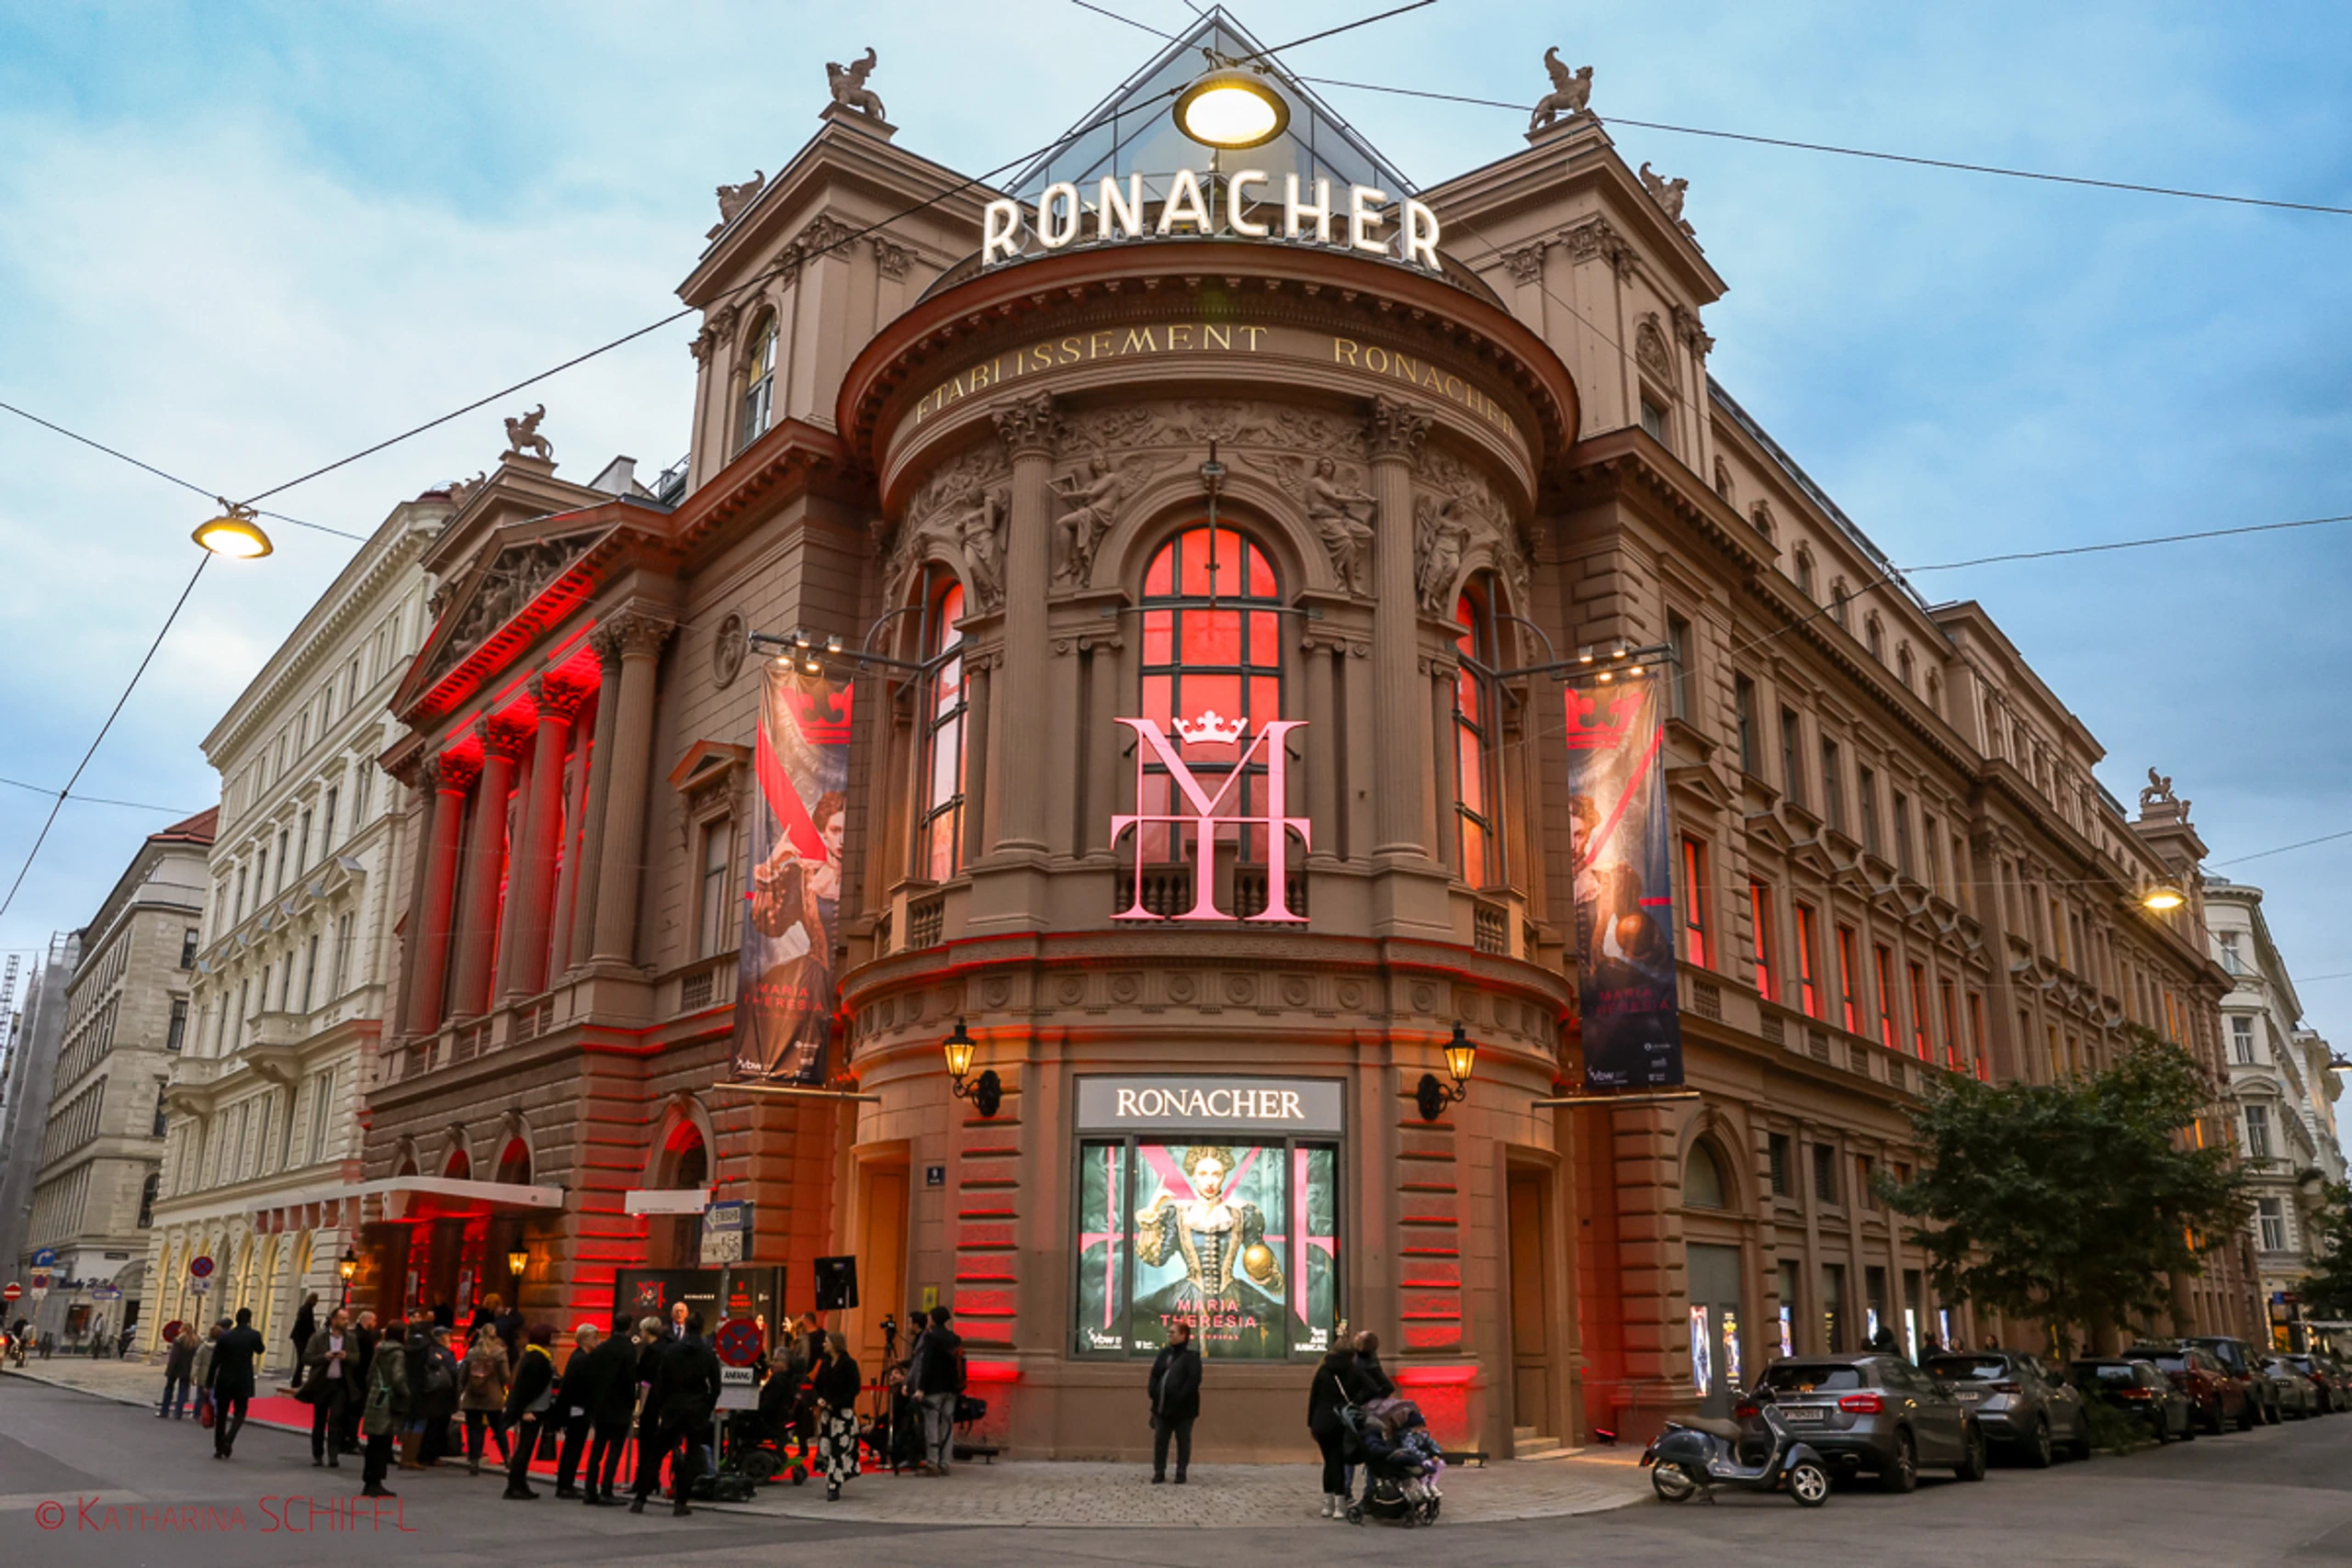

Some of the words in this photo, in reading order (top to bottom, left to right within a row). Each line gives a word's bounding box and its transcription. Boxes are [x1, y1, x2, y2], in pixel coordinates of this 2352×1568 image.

[981, 168, 1442, 273] RONACHER
[917, 323, 1268, 424] ETABLISSEMENT
[1333, 336, 1515, 438] RONACHER
[757, 983, 809, 998] MARIA
[1600, 987, 1653, 1001] MARIA
[743, 993, 824, 1012] THERESIA
[1115, 1088, 1306, 1119] RONACHER
[1177, 1299, 1239, 1313] MARIA
[1159, 1314, 1258, 1328] THERESIA
[723, 1371, 751, 1382] ANFANG
